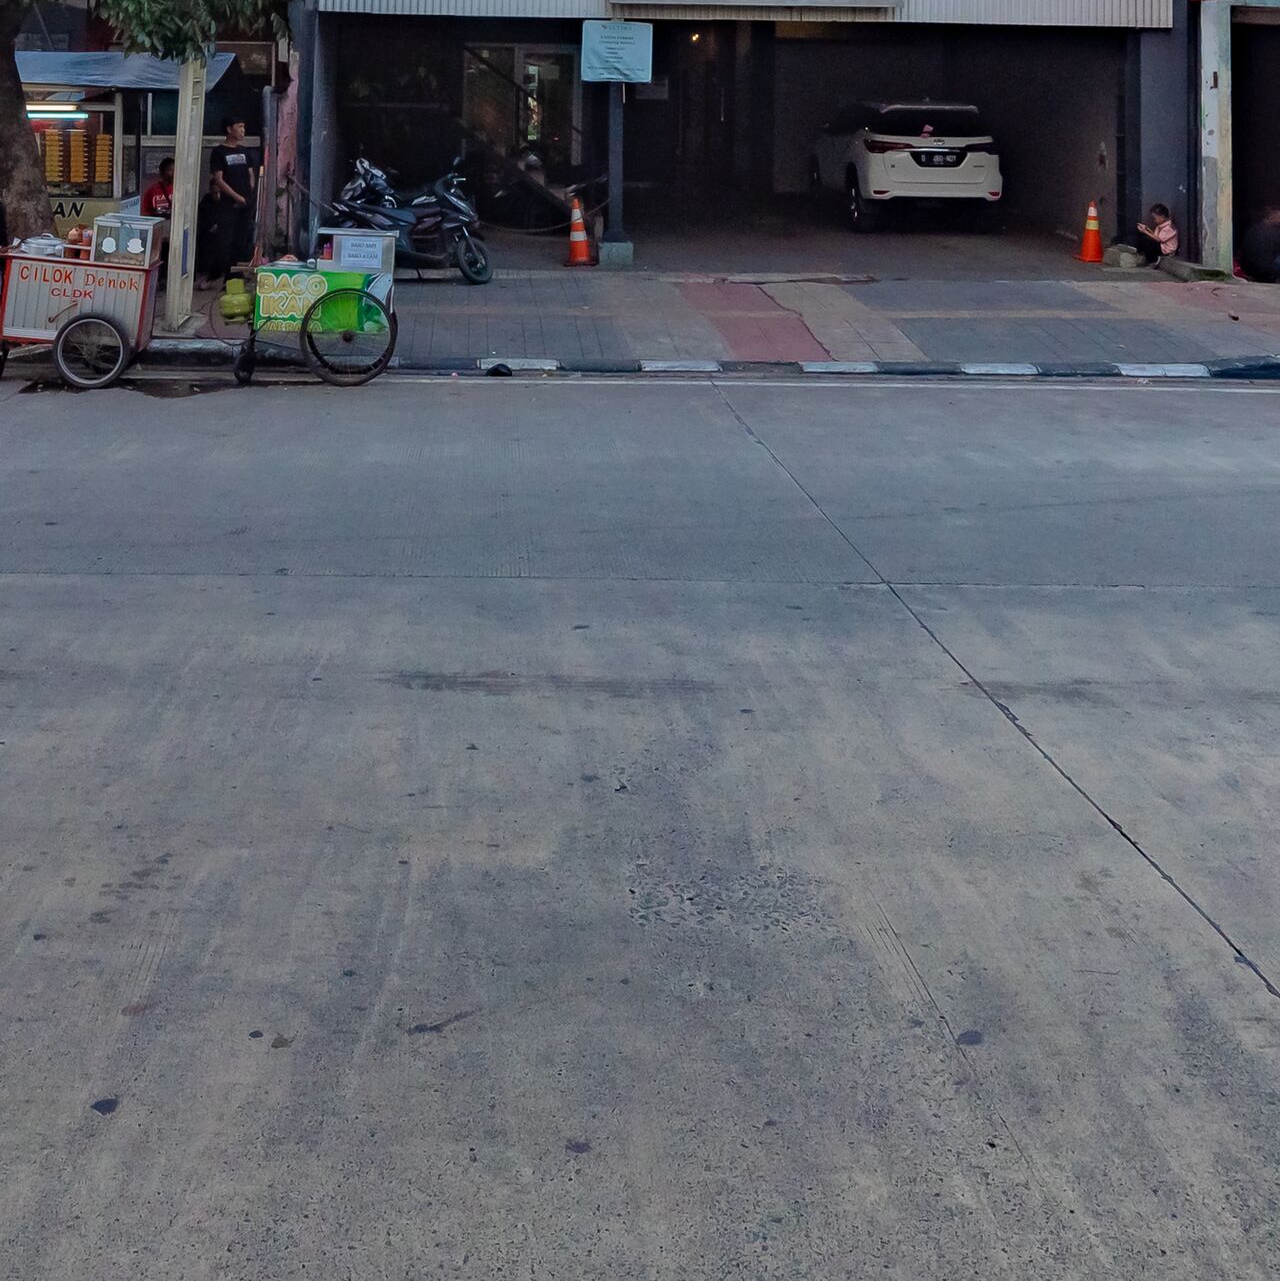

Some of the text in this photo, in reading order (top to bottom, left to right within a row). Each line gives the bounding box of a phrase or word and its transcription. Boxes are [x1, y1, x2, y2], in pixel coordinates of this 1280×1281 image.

[20, 266, 139, 290] CILOK Denok
[258, 274, 327, 296] BASO
[51, 288, 93, 299] CLDK
